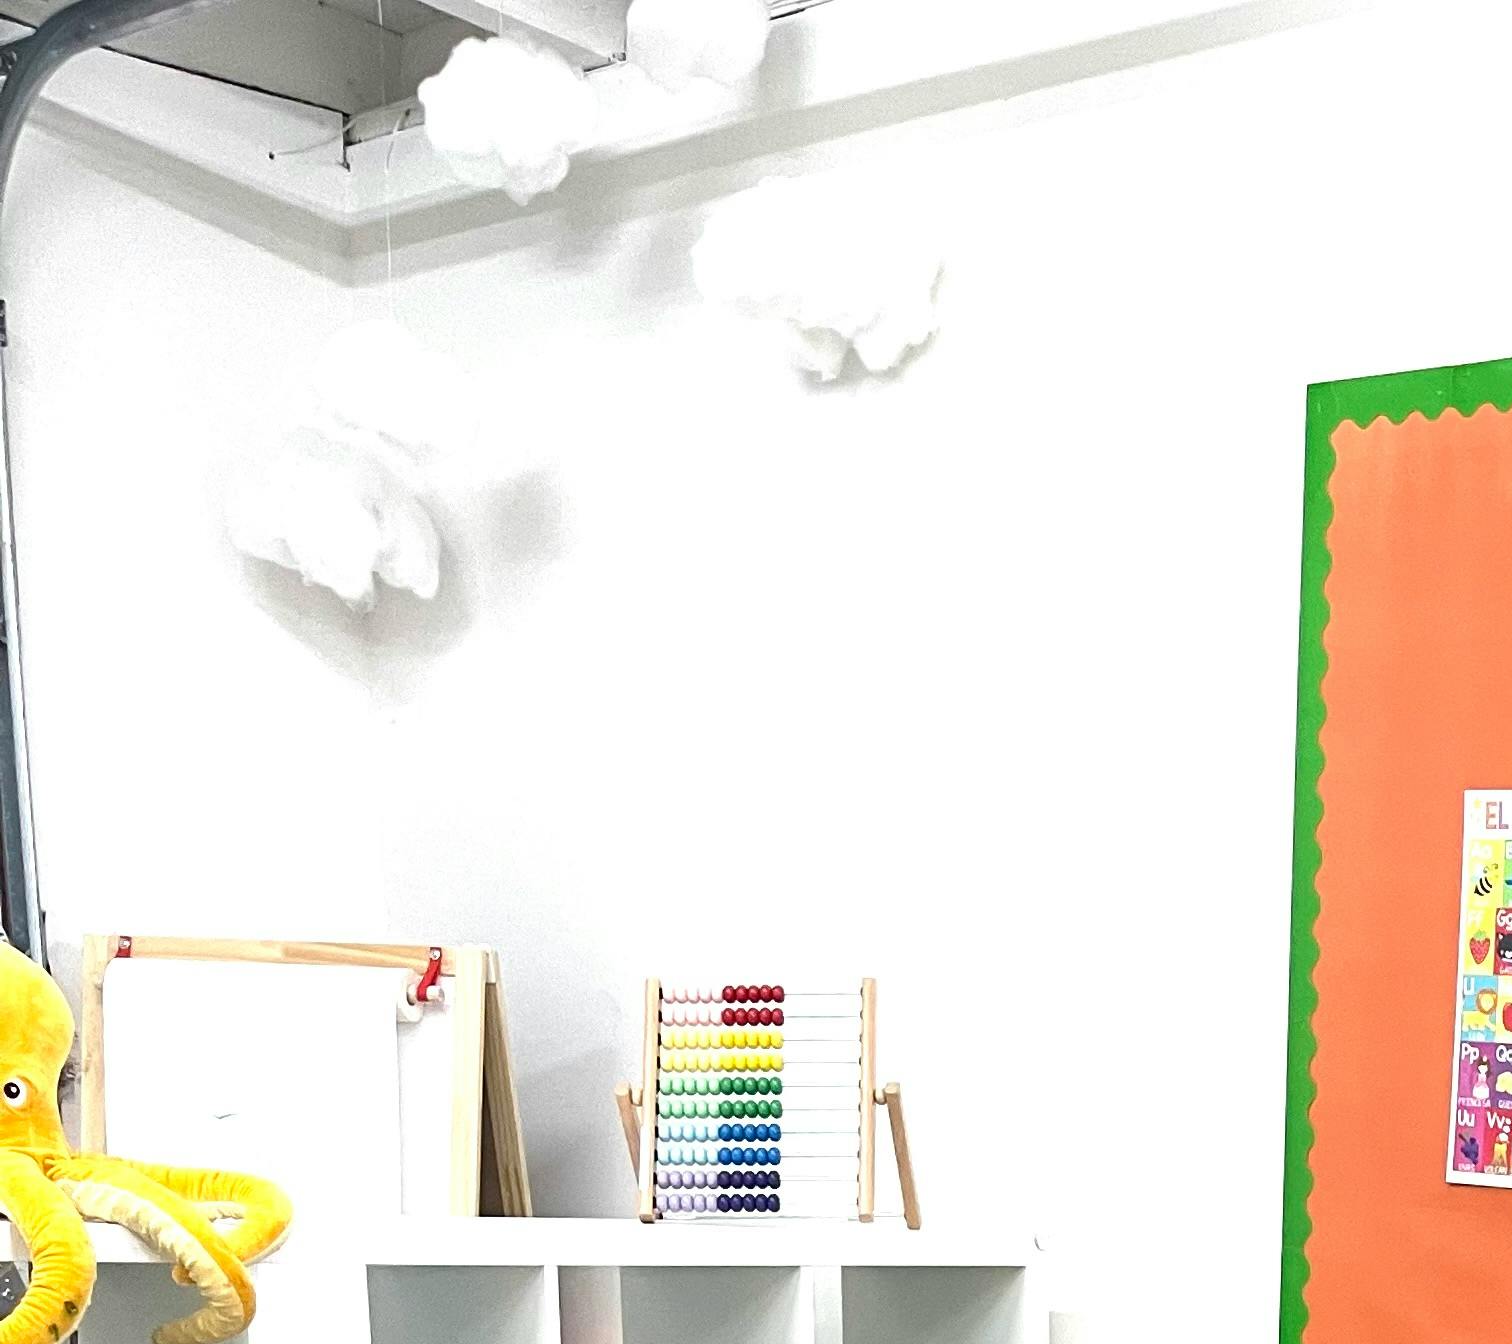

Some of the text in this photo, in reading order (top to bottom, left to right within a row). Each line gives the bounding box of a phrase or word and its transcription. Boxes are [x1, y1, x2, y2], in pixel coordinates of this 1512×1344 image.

[1485, 801, 1509, 829] EL
[1461, 1043, 1479, 1064] Pp
[1457, 1108, 1475, 1128] Uu
[1486, 1111, 1506, 1128] Vv
